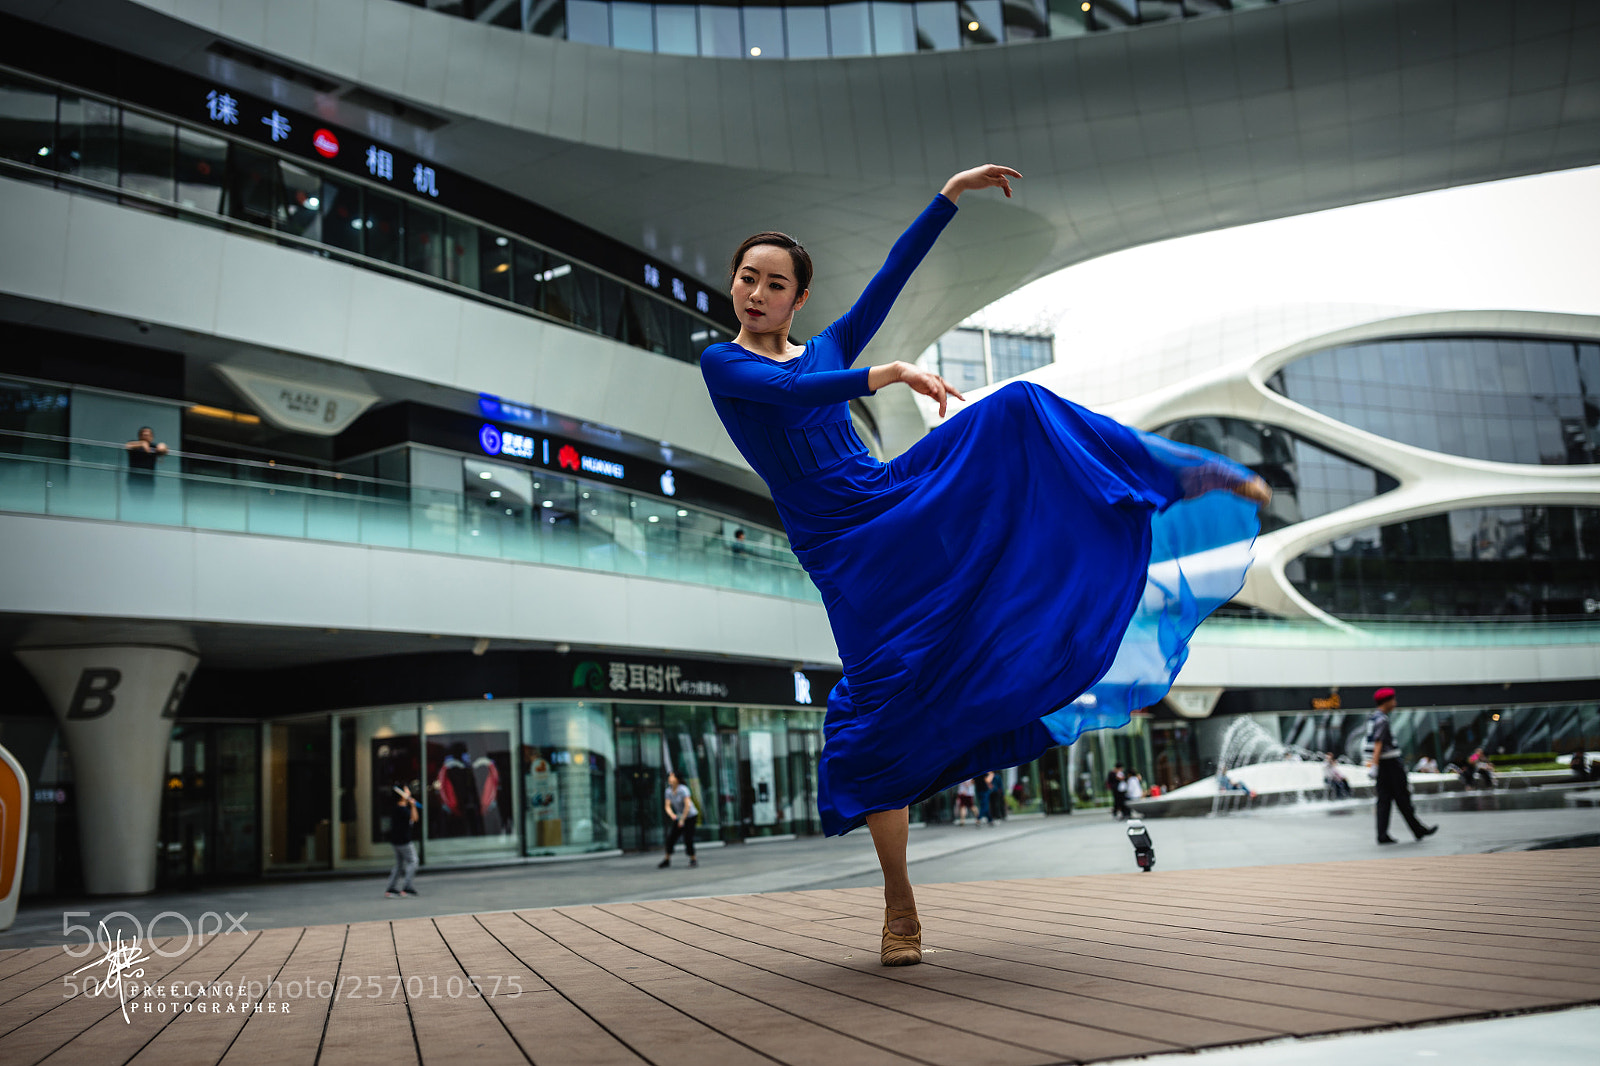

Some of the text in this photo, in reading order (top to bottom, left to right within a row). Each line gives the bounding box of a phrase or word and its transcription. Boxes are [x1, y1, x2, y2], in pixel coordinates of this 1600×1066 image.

[205, 89, 439, 198] 徕卡 相机
[581, 455, 625, 480] HUAWEI
[65, 667, 122, 721] B
[607, 661, 682, 694] 爱耳时代
